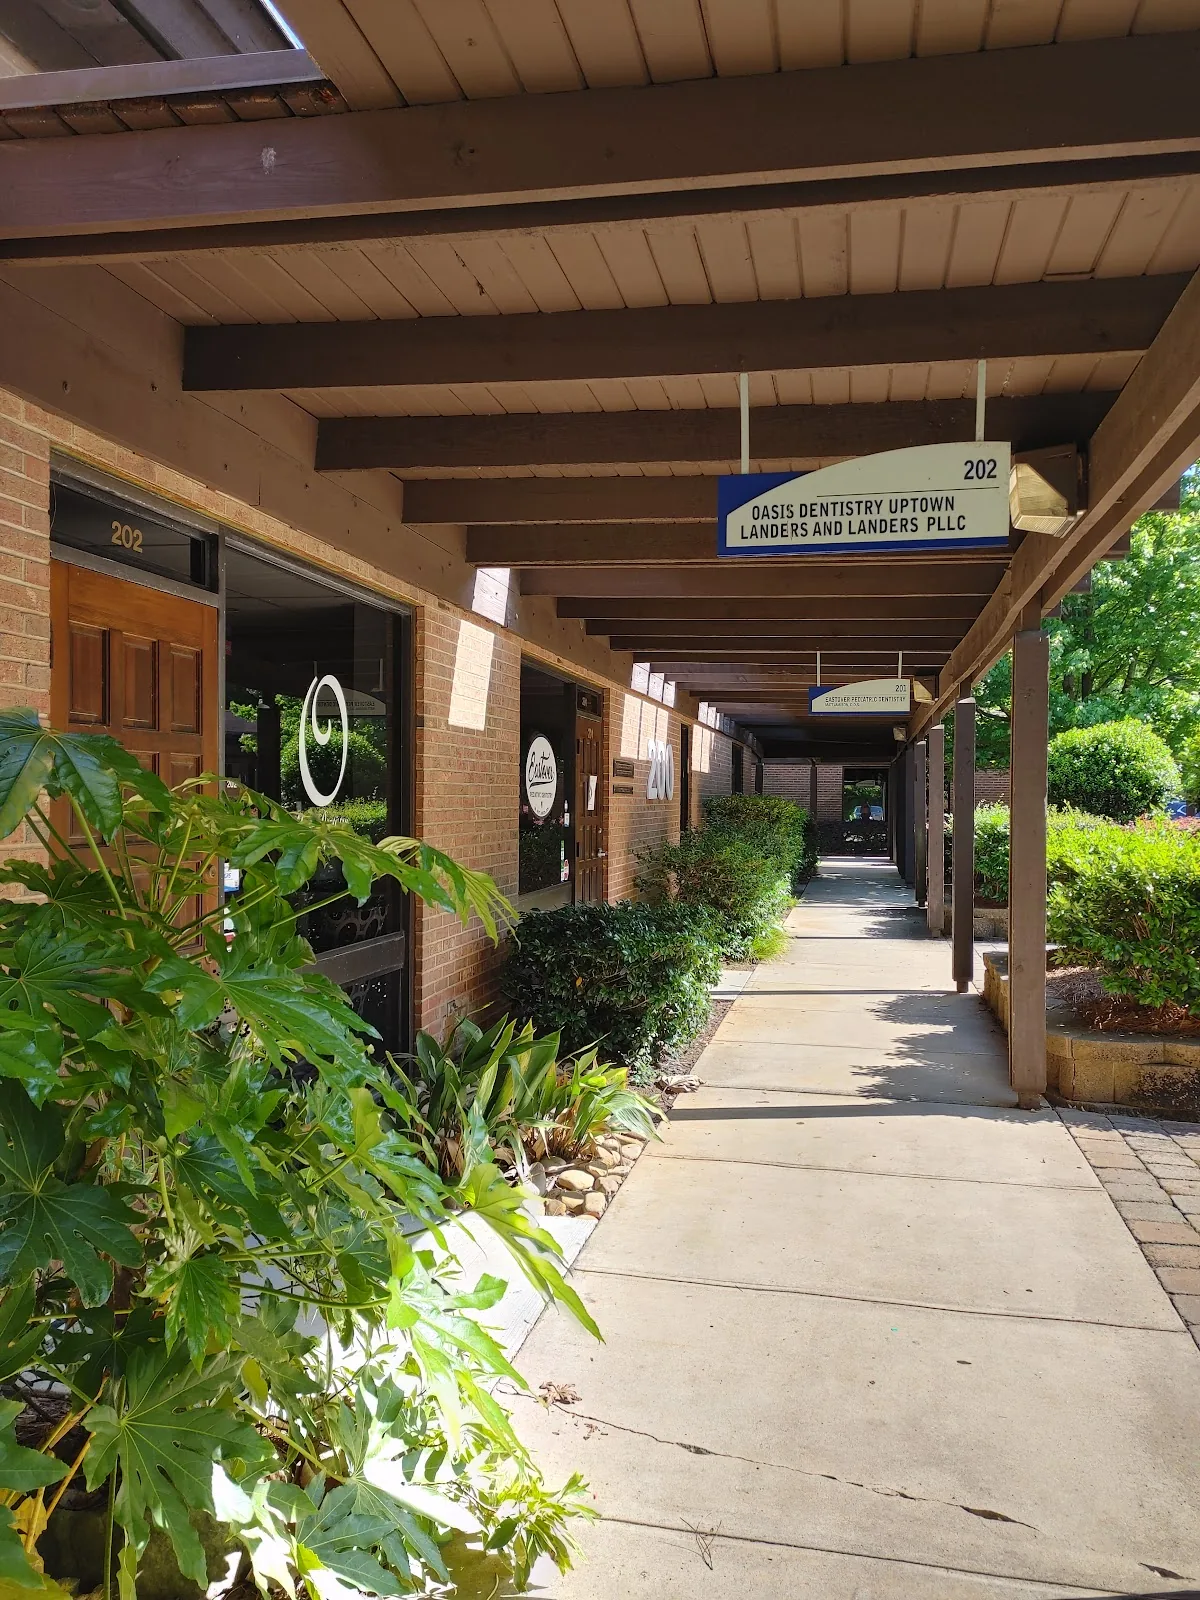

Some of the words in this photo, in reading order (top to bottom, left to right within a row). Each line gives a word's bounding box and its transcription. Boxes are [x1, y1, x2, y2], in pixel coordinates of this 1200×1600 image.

[963, 459, 997, 480] 202
[751, 504, 794, 521] OASIS
[799, 500, 883, 519] DENTISTRY
[889, 496, 955, 514] UPTOWN
[112, 521, 142, 552] 202
[740, 521, 808, 540] LANDERS
[812, 520, 843, 537] AND
[848, 517, 919, 536] LANDERS
[927, 515, 966, 532] PLLC
[895, 684, 907, 693] 201
[647, 739, 674, 800] 200
